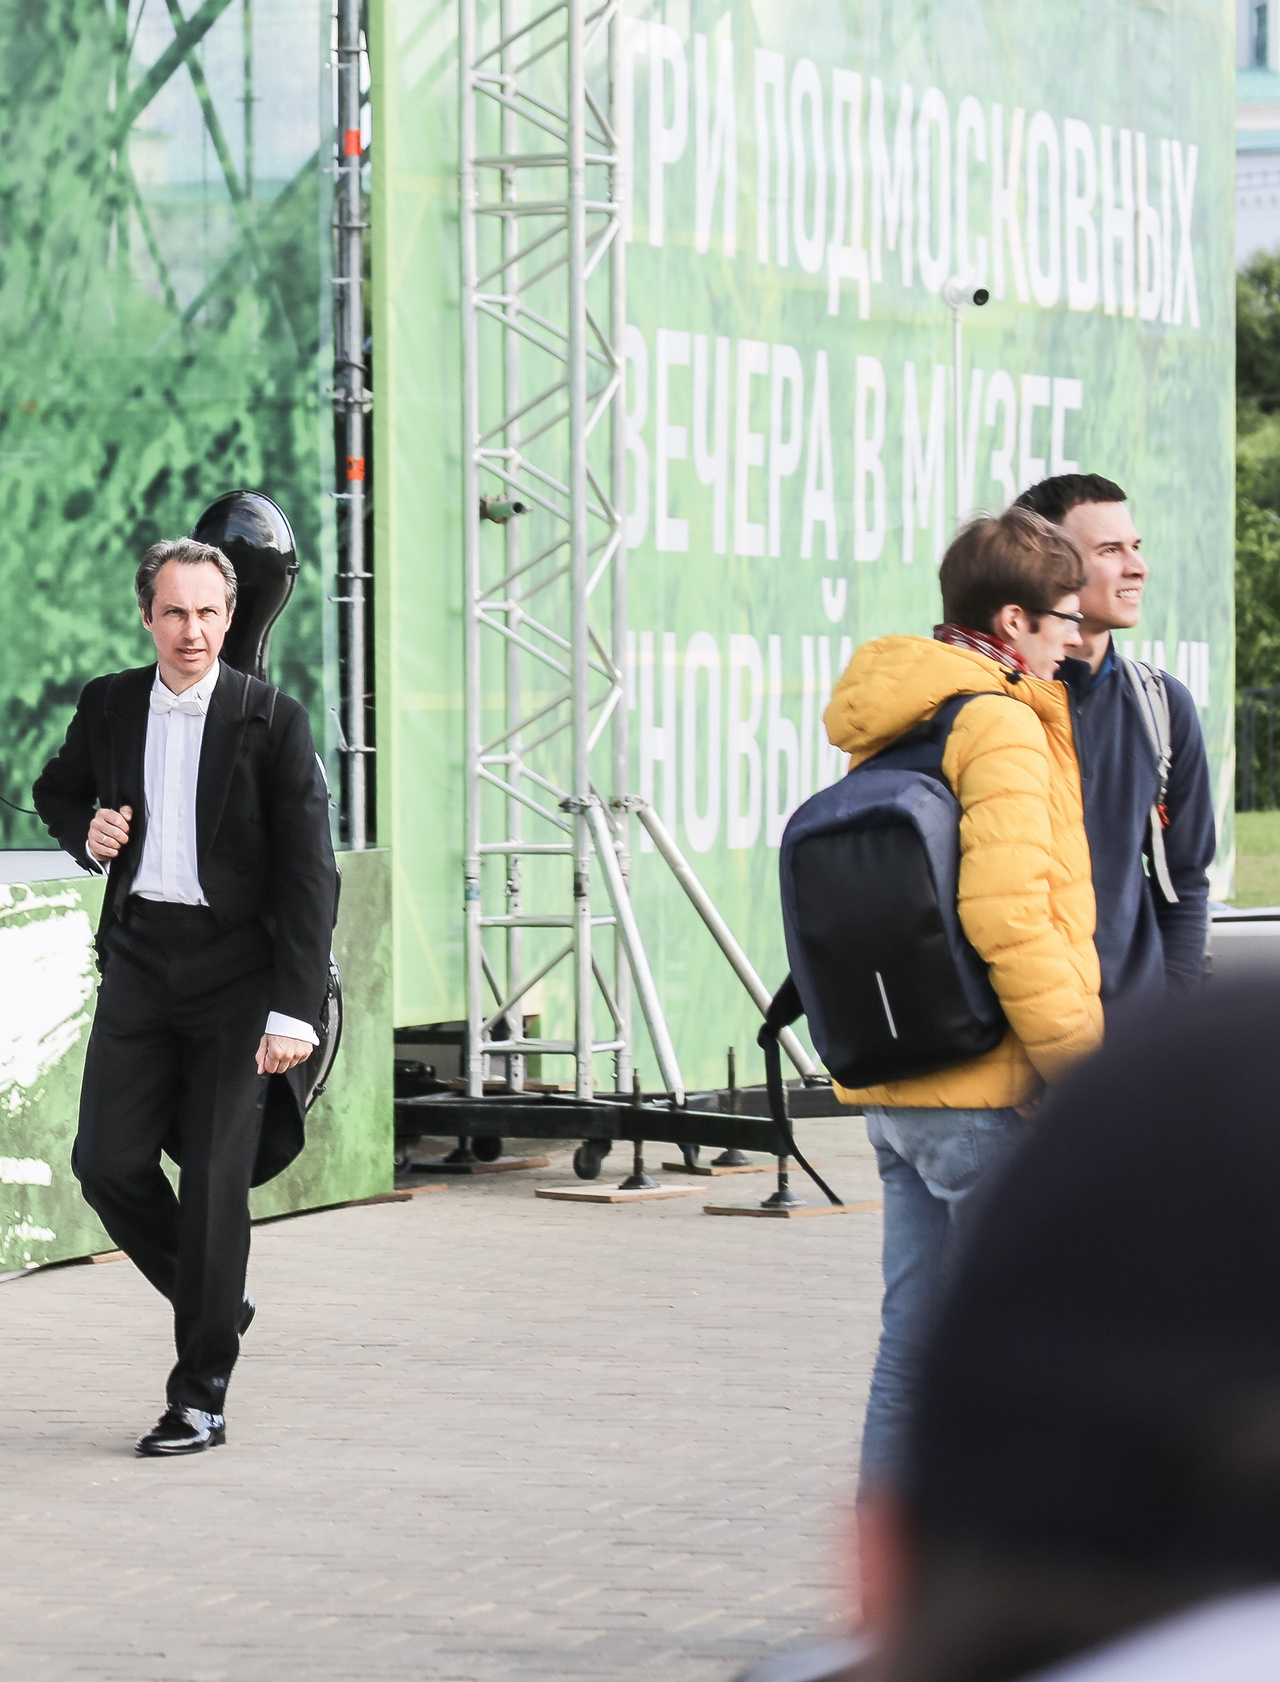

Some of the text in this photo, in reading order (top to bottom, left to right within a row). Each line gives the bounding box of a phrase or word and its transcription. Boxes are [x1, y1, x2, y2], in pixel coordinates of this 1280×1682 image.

[755, 46, 1201, 329] ПОДМОСКОВНЫХ
[624, 322, 839, 562] ВЕЧЕРА
[853, 354, 887, 562] В
